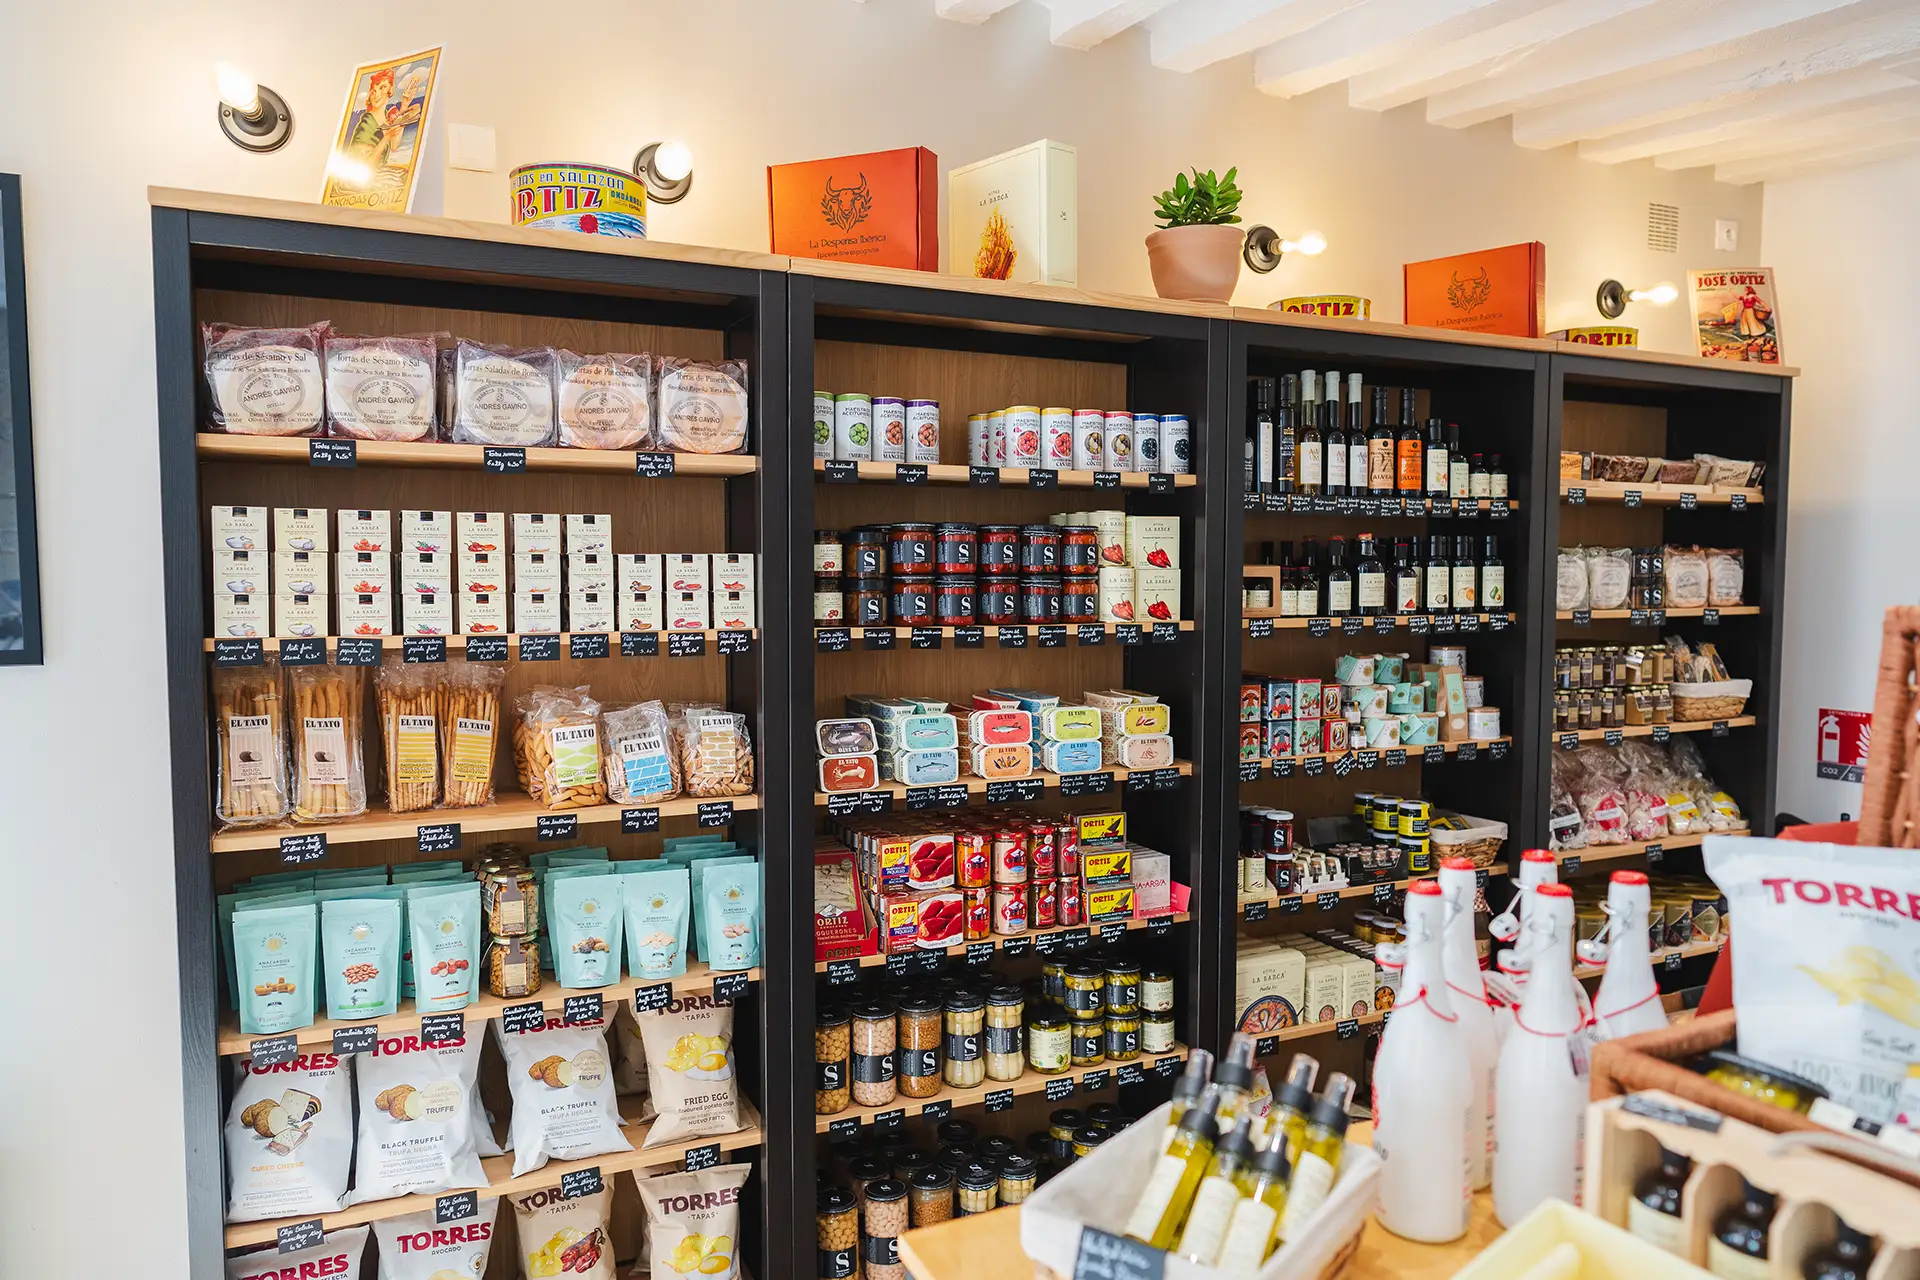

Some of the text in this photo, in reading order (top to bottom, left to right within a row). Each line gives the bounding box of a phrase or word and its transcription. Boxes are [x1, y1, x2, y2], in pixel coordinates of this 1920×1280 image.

[511, 185, 603, 222] RTIZ
[821, 238, 858, 248] Despensa
[1698, 275, 1766, 288] JOSÉ ORTIZ
[337, 352, 360, 363] Tortas
[361, 355, 371, 363] de
[372, 355, 401, 366] Sésamo
[511, 368, 520, 376] de
[243, 388, 273, 402] ANDRÉS
[357, 396, 387, 404] ANDRÉS
[579, 406, 605, 415] ANDRÉS
[673, 413, 698, 422] ANDRÉS
[914, 543, 924, 557] S
[959, 544, 968, 557] S
[914, 596, 925, 609] S
[231, 718, 268, 728] EL TATO
[305, 719, 340, 728] EL TATO
[401, 718, 433, 727] EL TATO
[458, 721, 490, 731] EL TATO
[702, 717, 732, 727] EL TATO
[555, 728, 595, 743] EL TATO
[624, 739, 660, 754] EL TATO
[1822, 767, 1839, 775] CO2
[1083, 820, 1105, 828] ORTIZ
[883, 845, 908, 855] ORTIZ
[1089, 857, 1111, 866] ORTIZ
[1092, 894, 1115, 903] ORTIZ
[891, 904, 916, 915] ORTIZ
[817, 916, 849, 927] ORTIZ
[815, 928, 857, 938] OQUERONES
[825, 946, 862, 959] ORTIZ
[1263, 972, 1285, 982] BARCA
[658, 995, 734, 1016] ORRES
[964, 1038, 976, 1052] S
[923, 1051, 935, 1067] S
[309, 1070, 335, 1079] SELECTA
[578, 1073, 601, 1081] TRUFFE
[825, 1066, 837, 1080] S
[684, 1092, 728, 1106] FRIED EGG
[425, 1105, 454, 1114] TRUFFE
[540, 1100, 597, 1115] BLACK TRUFFLE
[549, 1112, 570, 1120] TRUFA
[381, 1135, 444, 1150] BLACK TRUFFLE
[277, 1161, 304, 1170] CHEESE
[659, 1187, 742, 1215] TORRES
[397, 1222, 491, 1253] TORRES
[431, 1246, 461, 1256] AVOCADO
[836, 1252, 849, 1267] S
